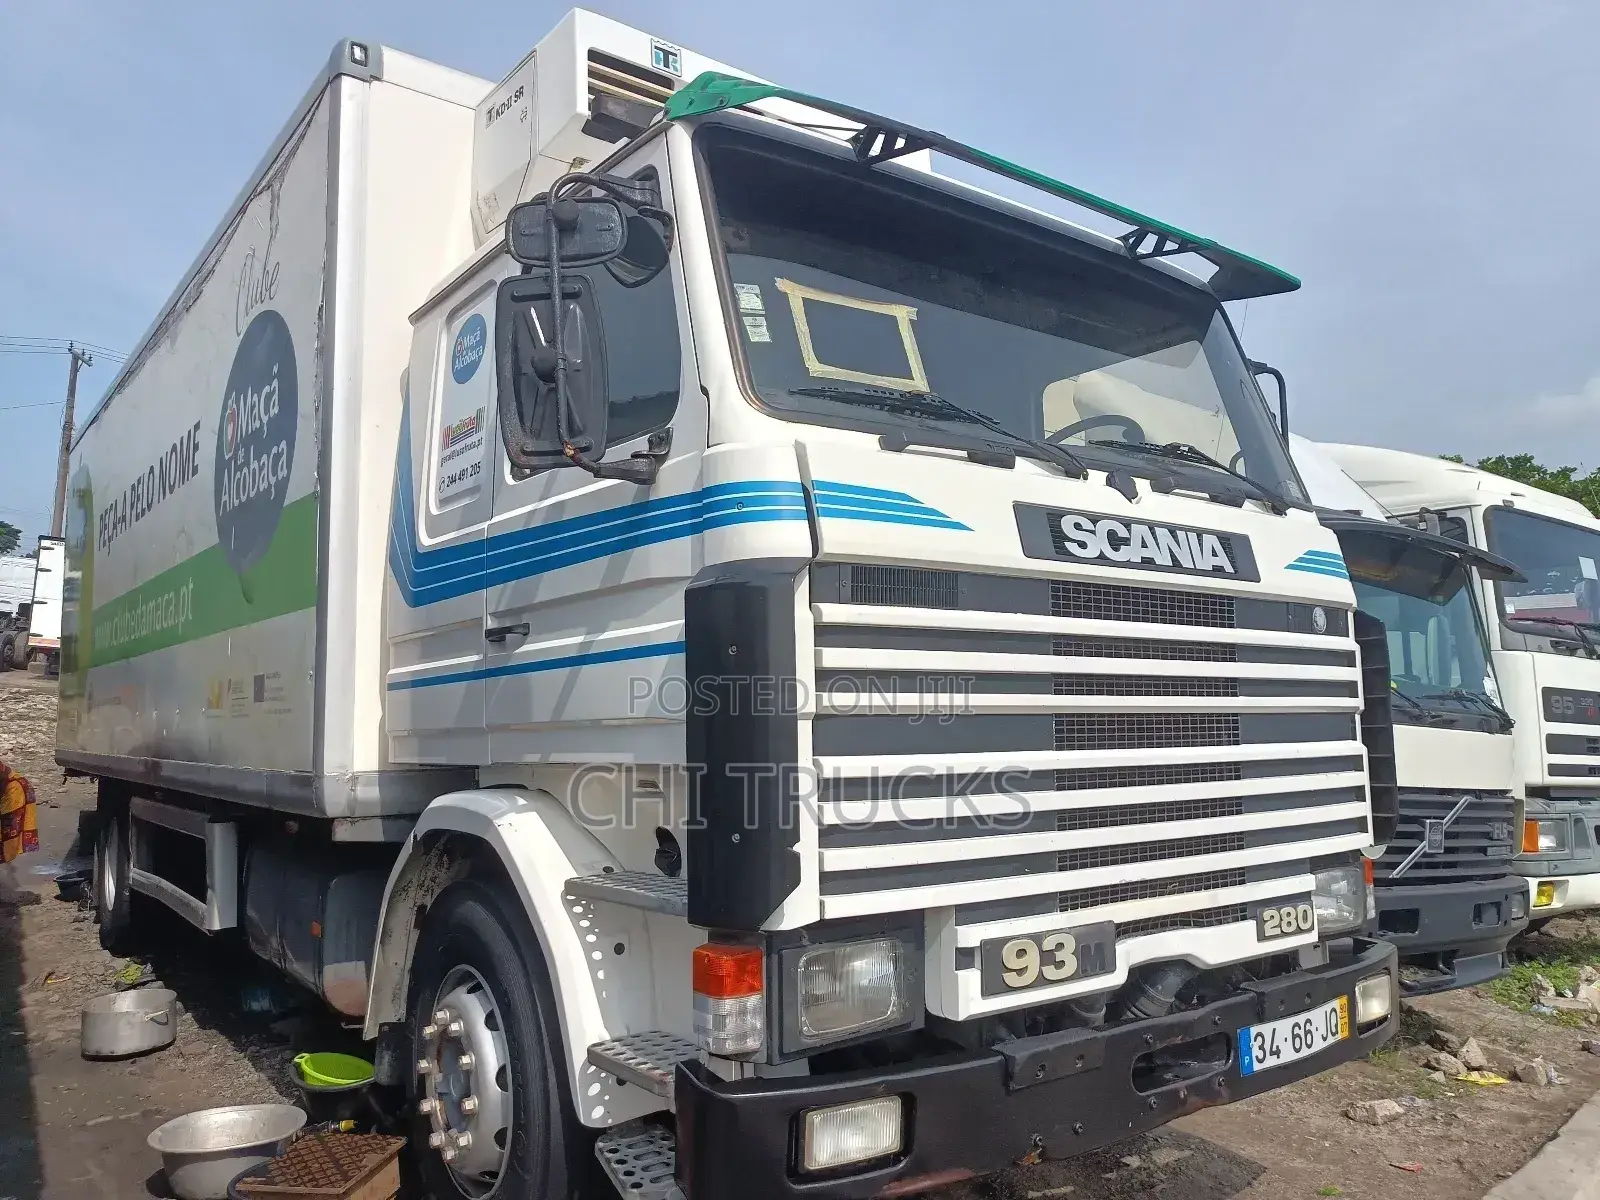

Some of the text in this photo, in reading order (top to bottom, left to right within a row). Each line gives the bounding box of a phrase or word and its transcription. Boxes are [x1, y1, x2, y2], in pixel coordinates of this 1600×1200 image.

[236, 228, 280, 338] Clube
[453, 345, 483, 373] Alcobaça
[237, 362, 280, 443] Maçã
[237, 443, 245, 466] de
[98, 419, 201, 557] PEÇA-A PELO NOME
[219, 439, 288, 517] Alcobaça
[446, 460, 482, 488] 244 491 205
[1060, 514, 1236, 574] SCANIA
[1550, 695, 1575, 715] 95
[1262, 904, 1313, 937] 280
[1244, 1055, 1250, 1066] P
